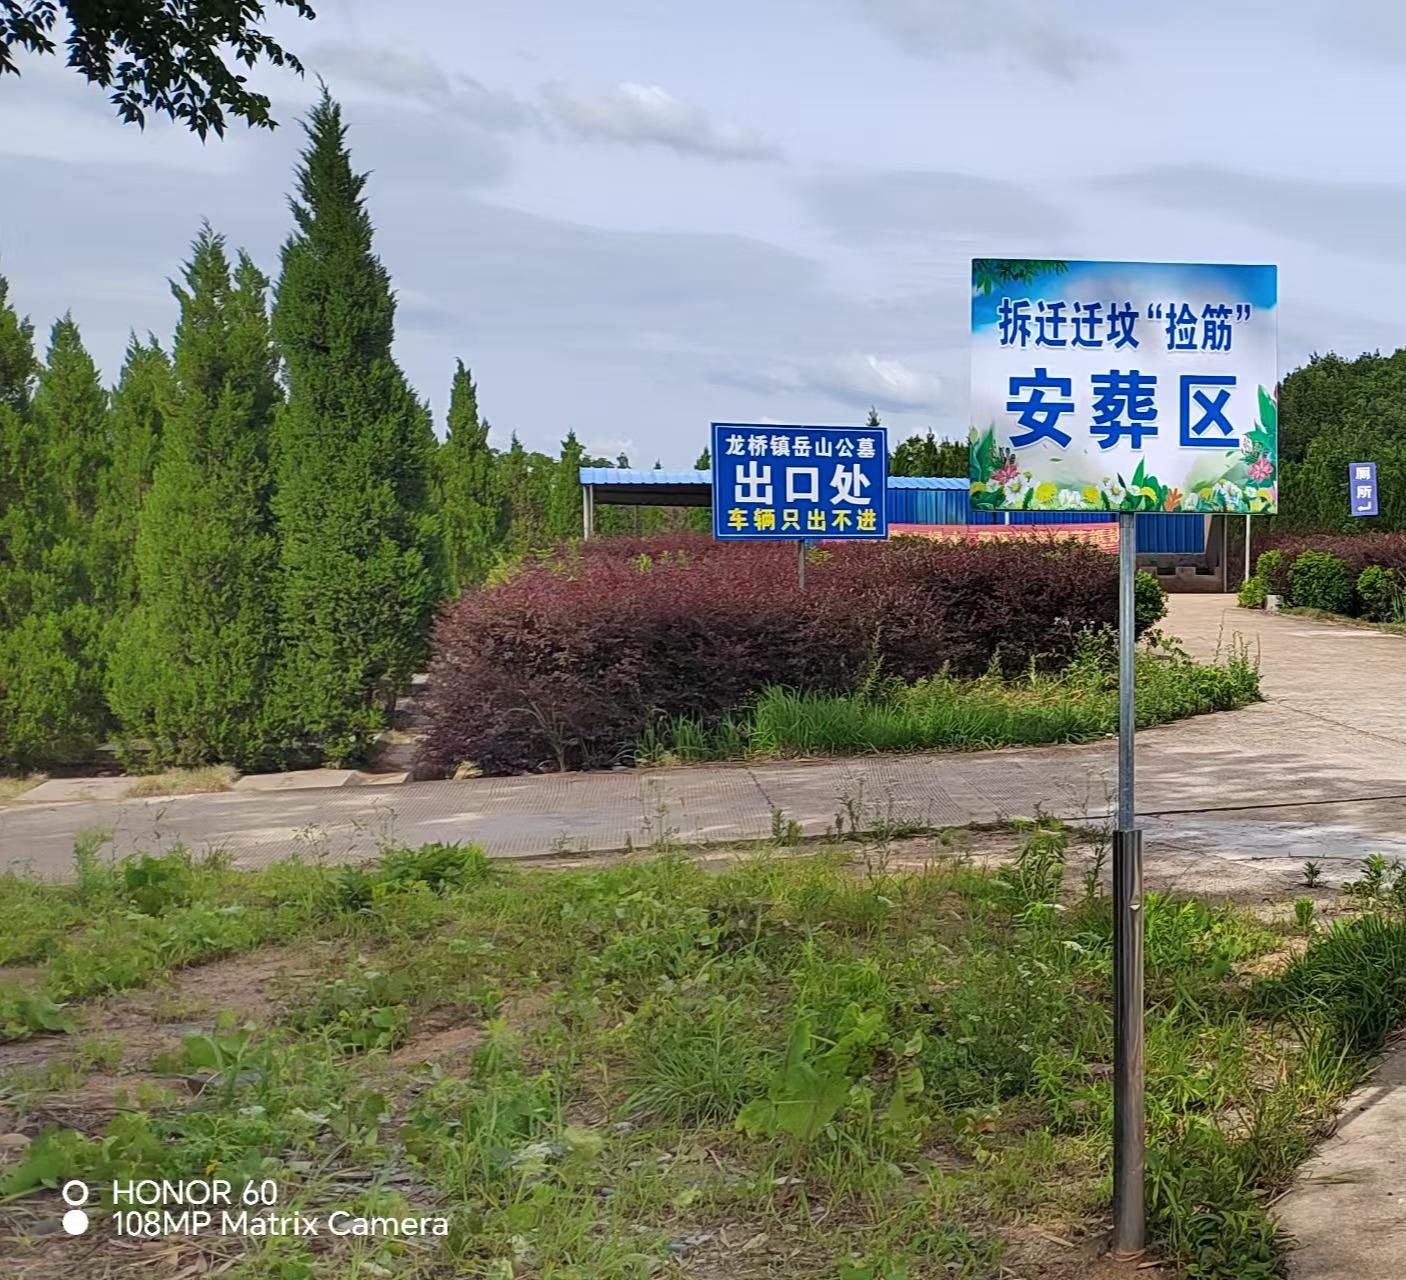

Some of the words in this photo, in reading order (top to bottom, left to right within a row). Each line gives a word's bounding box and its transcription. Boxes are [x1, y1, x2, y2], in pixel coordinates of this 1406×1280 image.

[1006, 367, 1240, 449] 安葬区
[725, 434, 876, 458] 龙桥镇岳山公墓
[734, 461, 872, 505] 出口处
[1355, 466, 1372, 499] 厕所
[727, 508, 877, 531] 车辆只出不进
